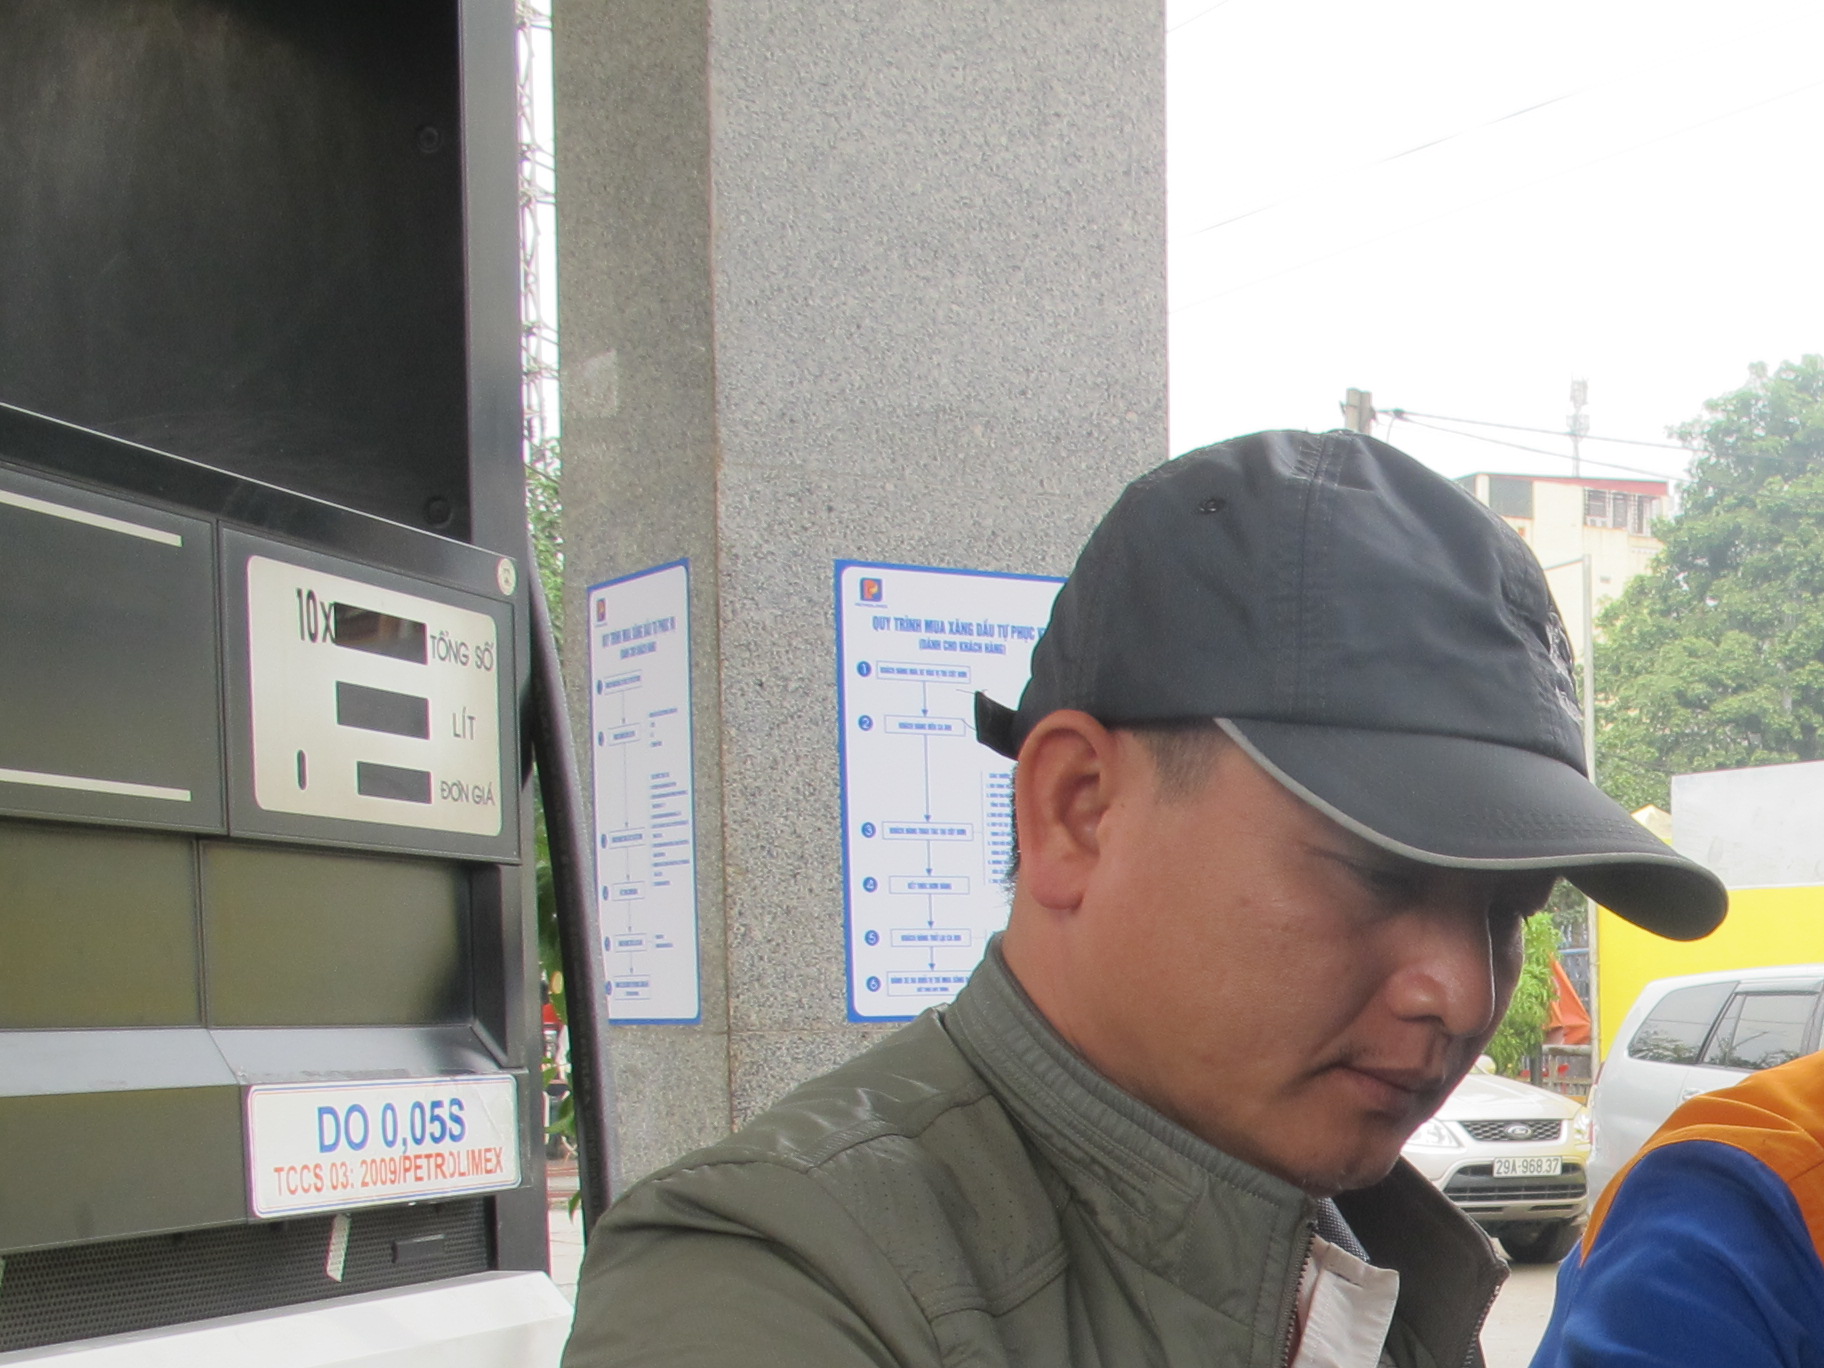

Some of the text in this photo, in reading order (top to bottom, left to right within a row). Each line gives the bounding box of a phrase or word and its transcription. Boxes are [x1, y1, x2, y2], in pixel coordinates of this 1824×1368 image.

[430, 630, 469, 666] TỔNG
[452, 706, 476, 740] LÍT
[472, 781, 496, 806] GIÁ
[317, 1098, 466, 1155] DO 0,05S
[274, 1163, 324, 1197] TCCS
